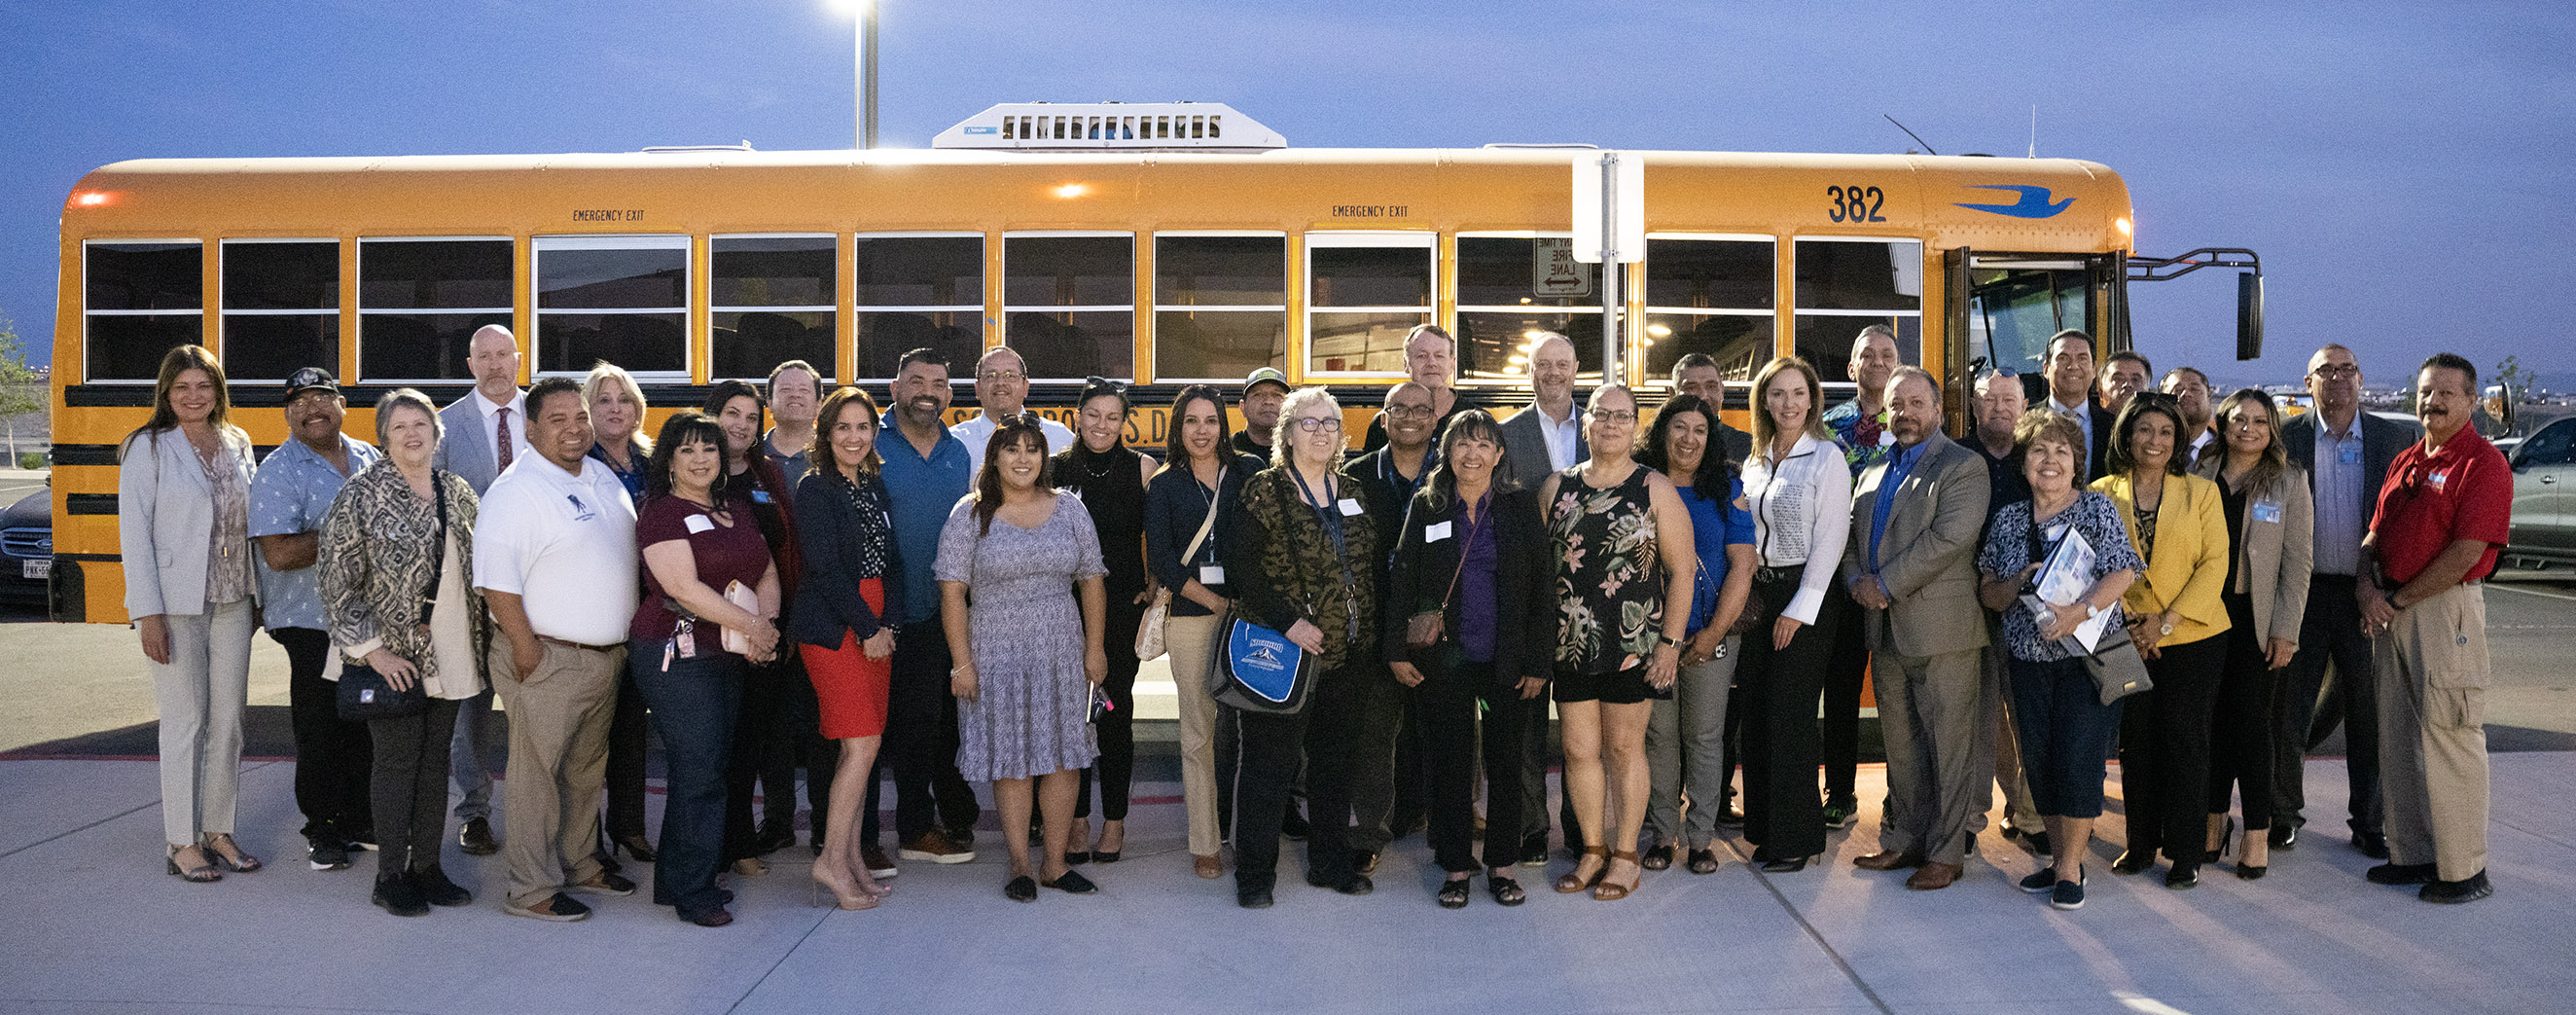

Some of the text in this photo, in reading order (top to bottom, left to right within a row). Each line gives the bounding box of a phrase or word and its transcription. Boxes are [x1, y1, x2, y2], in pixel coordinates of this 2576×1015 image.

[1828, 185, 1886, 223] 382
[573, 209, 644, 221] EMERGENCY EXIT
[1332, 205, 1408, 217] EMERGENCY EXIT
